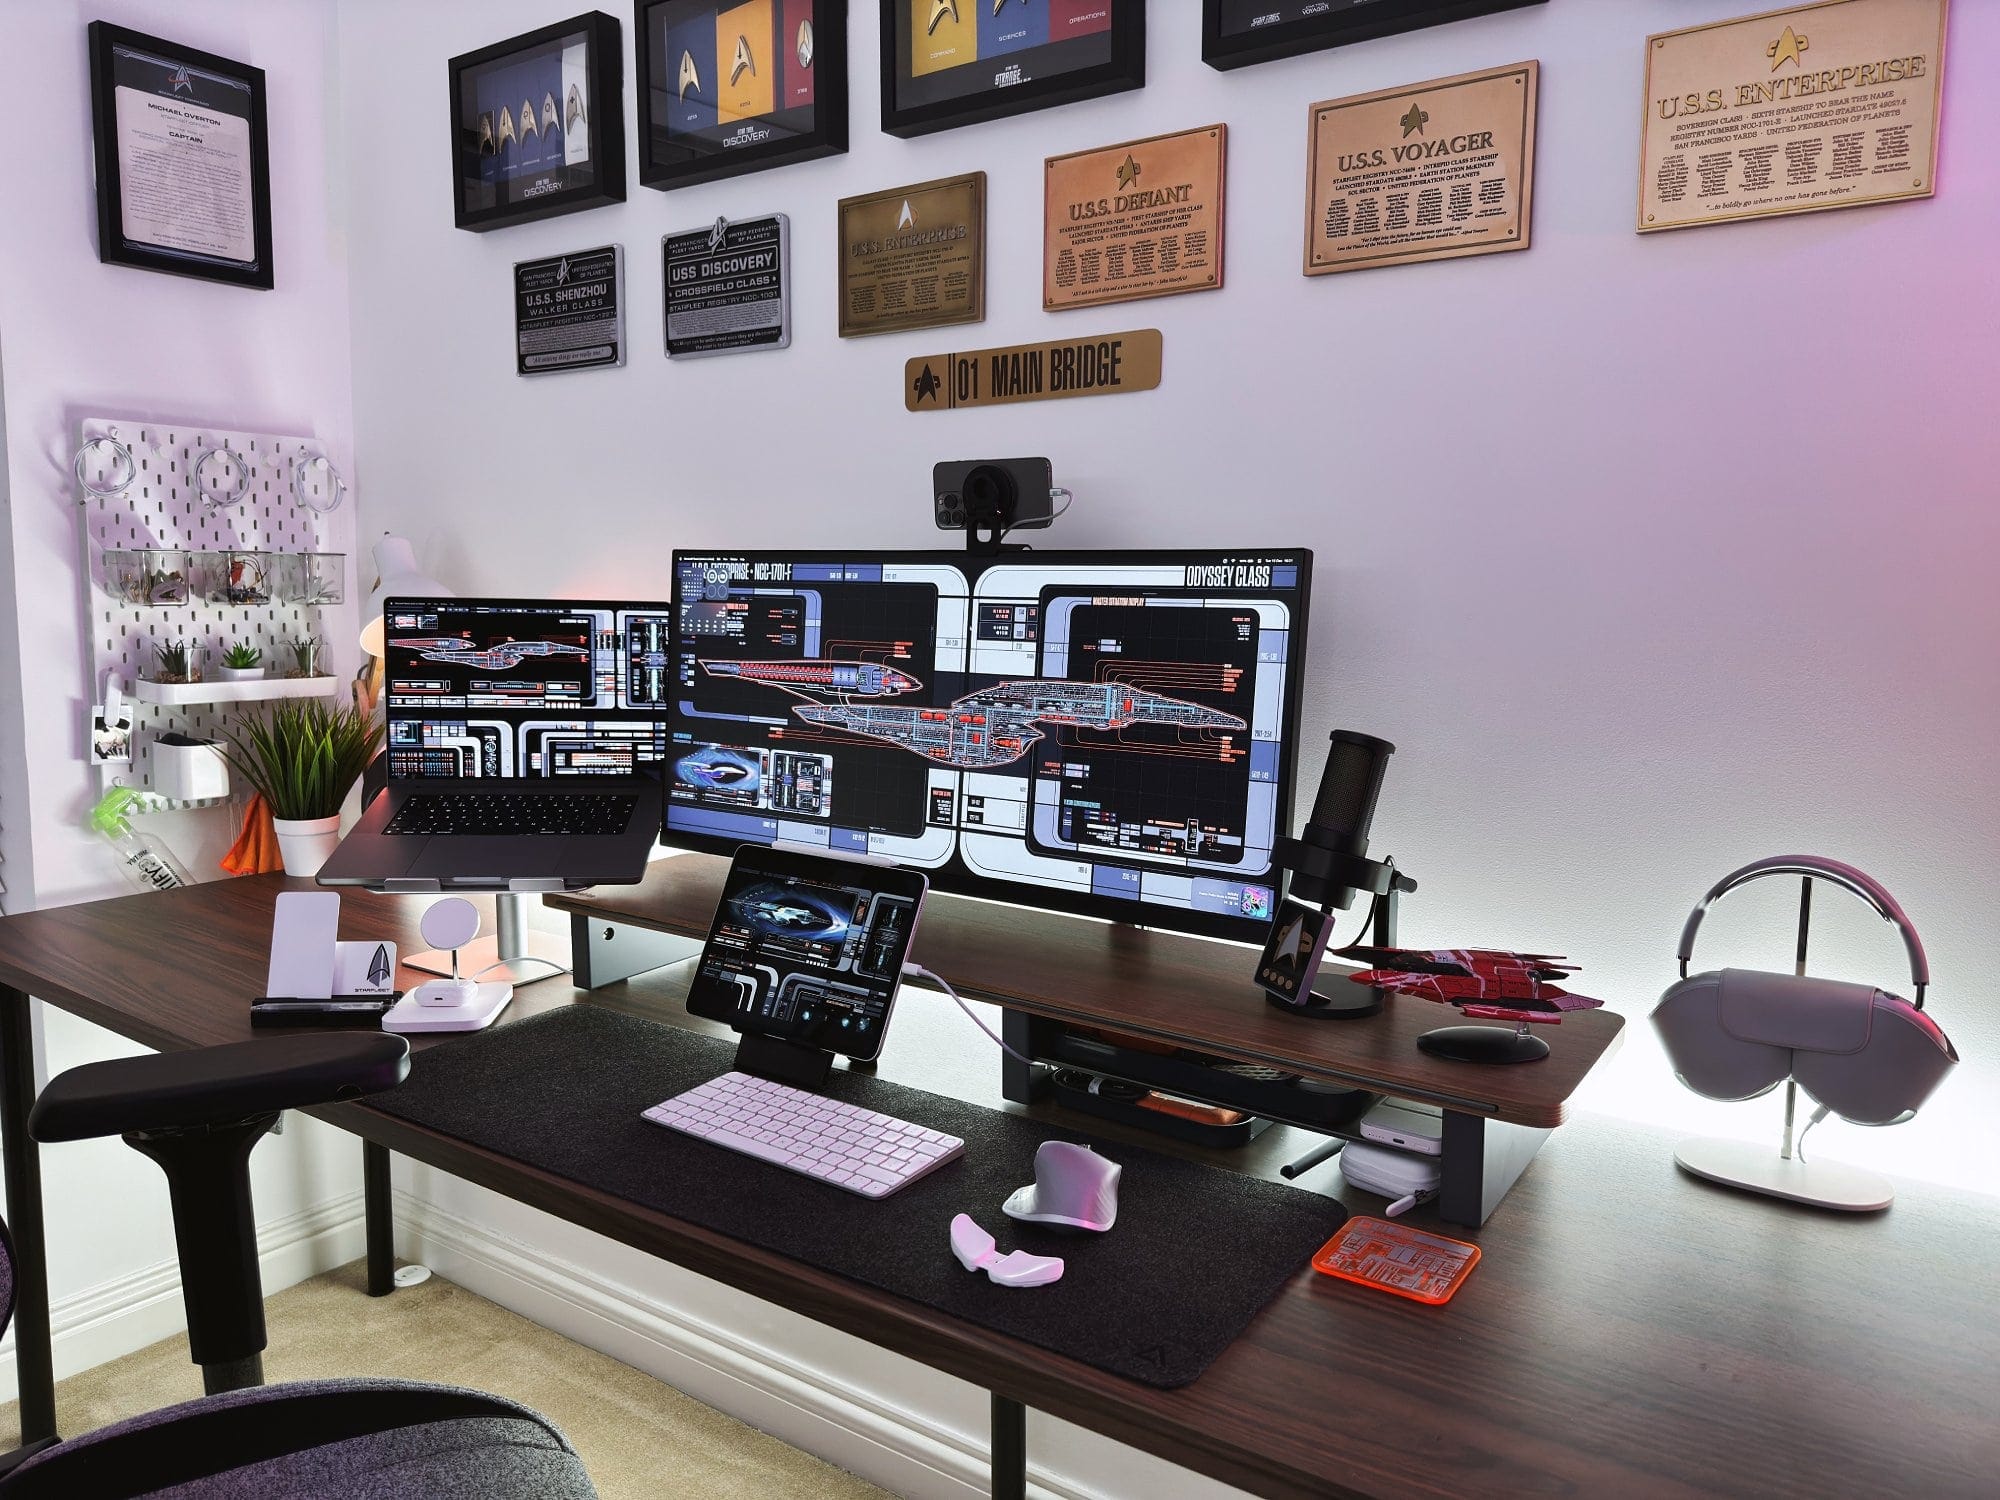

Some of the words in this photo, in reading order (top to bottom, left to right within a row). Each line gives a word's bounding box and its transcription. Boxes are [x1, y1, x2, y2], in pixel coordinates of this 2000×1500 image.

[998, 30, 1027, 42] SCIENCES
[1657, 89, 1728, 120] U.S.S.
[1734, 54, 1927, 108] ENTERPRISE
[148, 102, 184, 117] MICHAEL
[184, 111, 221, 126] OVERTON
[1670, 129, 1706, 142] REGISTRY
[1707, 124, 1739, 136] NUMBER
[1790, 109, 1835, 123] LAUNCHED
[1835, 102, 1878, 116] STARDATE
[1676, 118, 1719, 132] SOVEREIGN
[1719, 114, 1743, 125] CLASS
[1751, 109, 1775, 120] SIXTH
[1775, 103, 1814, 117] STARSHIP
[1815, 101, 1827, 109] TO
[1828, 97, 1850, 108] BEAR
[1850, 94, 1869, 104] THE
[1870, 90, 1895, 101] NAME
[168, 131, 203, 144] CAPTAIN
[723, 130, 770, 148] DISCOVERY
[1674, 141, 1689, 150] SAN
[1690, 135, 1732, 148] FRANCISCO
[1732, 131, 1758, 141] YARDS
[1766, 125, 1797, 136] UNITED
[1797, 117, 1849, 131] FEDERATION
[1850, 114, 1862, 123] OF
[1862, 108, 1901, 121] PLANETS
[1337, 150, 1387, 172] U.S.S.
[1391, 130, 1495, 163] VOYAGER
[1423, 161, 1450, 170] INTREPID
[1450, 157, 1469, 166] CLASS
[1469, 152, 1499, 163] STARSHIP
[523, 181, 563, 197] DISCOVERY
[1335, 181, 1365, 191] LAUNCHED
[1365, 177, 1394, 186] STARDATE
[1419, 170, 1439, 178] EARTH
[1439, 165, 1465, 175] STATION
[1359, 186, 1380, 195] SECTOR
[1387, 182, 1409, 190] UNITED
[1409, 175, 1445, 187] FEDERATION
[1454, 171, 1481, 180] PLANETS
[1069, 199, 1112, 221] U.S.S.
[1115, 183, 1193, 213] DEFIANT
[1722, 199, 1742, 209] boldly
[1752, 197, 1774, 205] where
[1811, 190, 1828, 199] gone
[1174, 213, 1192, 222] YARDS
[884, 225, 967, 252] ENTERPRISE
[672, 266, 697, 282] USS
[701, 252, 773, 278] DISCOVERY
[526, 293, 553, 307] U.S.S.
[555, 283, 607, 303] SHENZHOU
[674, 280, 734, 299] CROSSFIELD
[736, 275, 770, 289] CLASS
[529, 304, 568, 317] WALKER
[572, 298, 603, 310] CLASS
[669, 301, 706, 313] STARFLEET
[706, 295, 741, 307] REGISTRY
[958, 357, 979, 401] 01
[990, 349, 1043, 398] MAIN
[1049, 340, 1122, 392] BRIDGE
[753, 563, 793, 582] NCC-1701-F
[1186, 565, 1233, 587] ODYSSEY
[1234, 565, 1271, 588] CLASS
